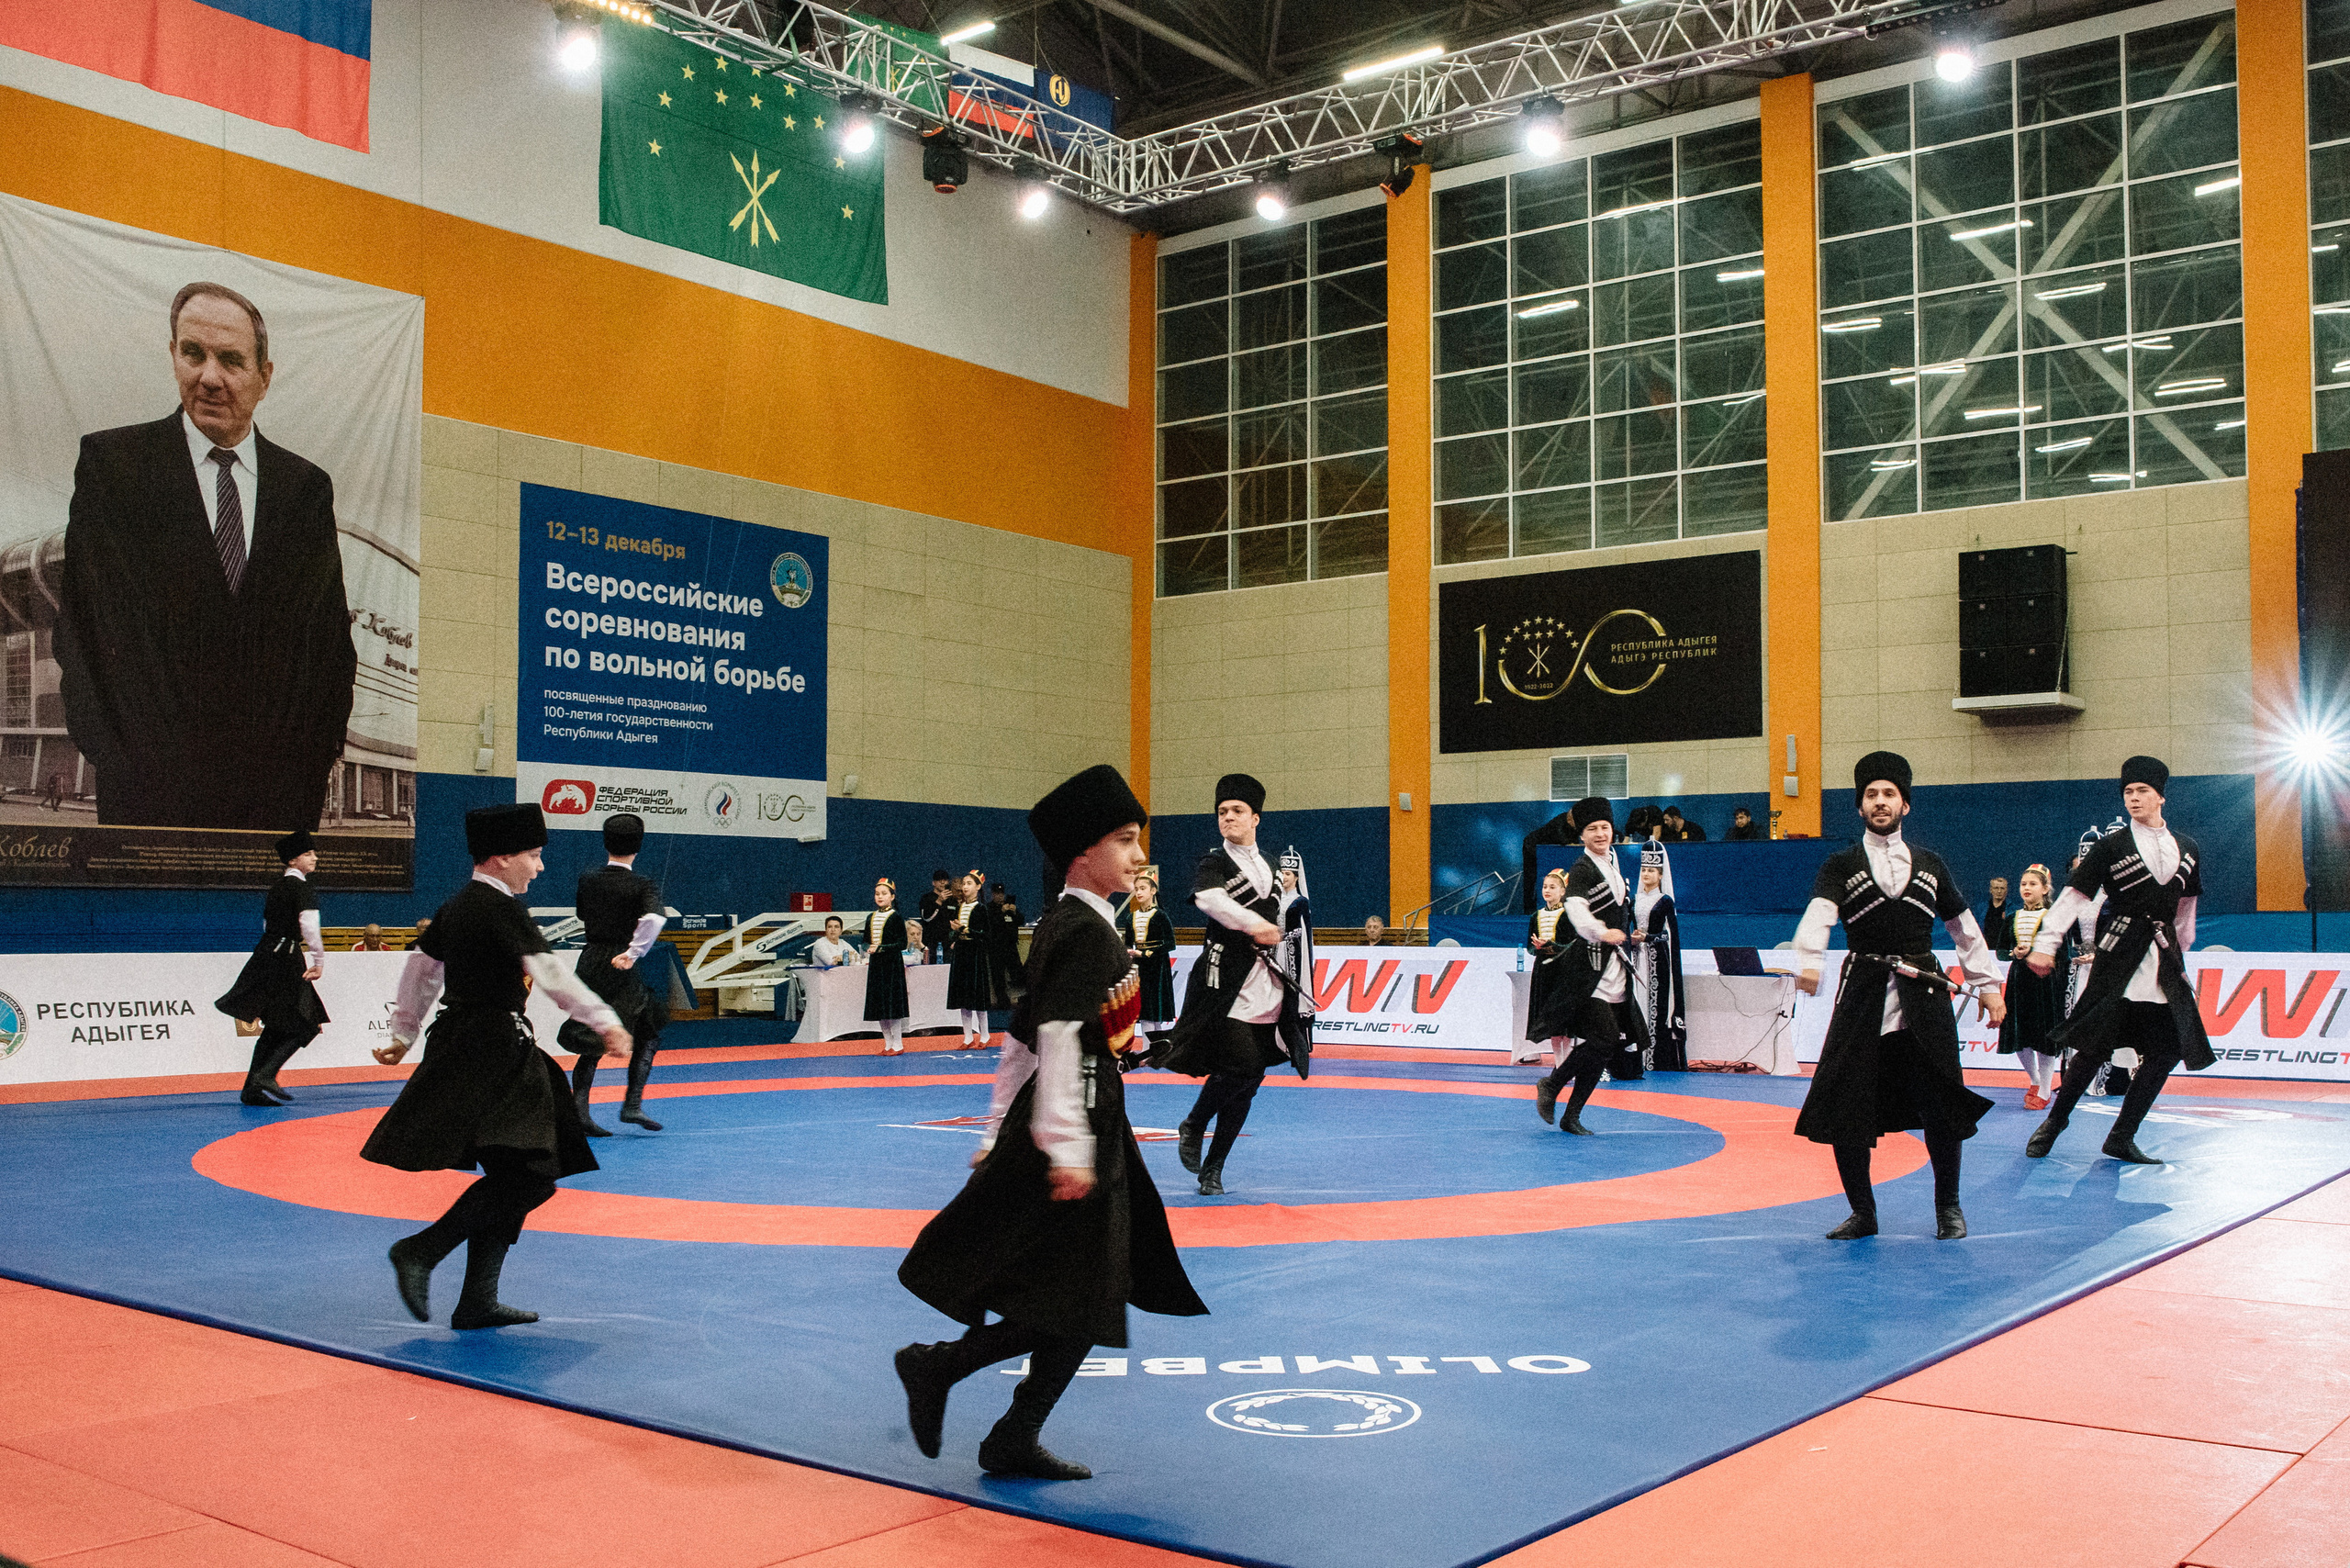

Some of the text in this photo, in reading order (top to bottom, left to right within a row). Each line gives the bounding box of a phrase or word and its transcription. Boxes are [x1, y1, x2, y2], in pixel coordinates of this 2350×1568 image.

[605, 533, 686, 561] декабря
[546, 562, 764, 617] Всероссийские
[545, 607, 745, 651] соревнования
[1611, 635, 1718, 652] РЕСПУБЛИКА АДЫГЕЯ
[1611, 647, 1718, 664] АДЫГЭ РЕСПУБЛИК
[545, 645, 806, 694] по вольной борьбе
[543, 689, 708, 712] посвященные празднованию
[543, 706, 713, 731] 100-летия государственности
[543, 723, 658, 744] Республики Адыгея
[596, 795, 673, 806] СПОРТИВНОЙ
[599, 786, 668, 797] ФЕДЕРАЦИЯ
[594, 803, 688, 815] БОРЬБЫ РОССИИ
[787, 924, 803, 935] Sports
[37, 999, 196, 1020] РЕСПУБЛИКА
[71, 1024, 171, 1046] АДЫГЕЯ
[1313, 1021, 1439, 1035] RESTLINGTV.RU
